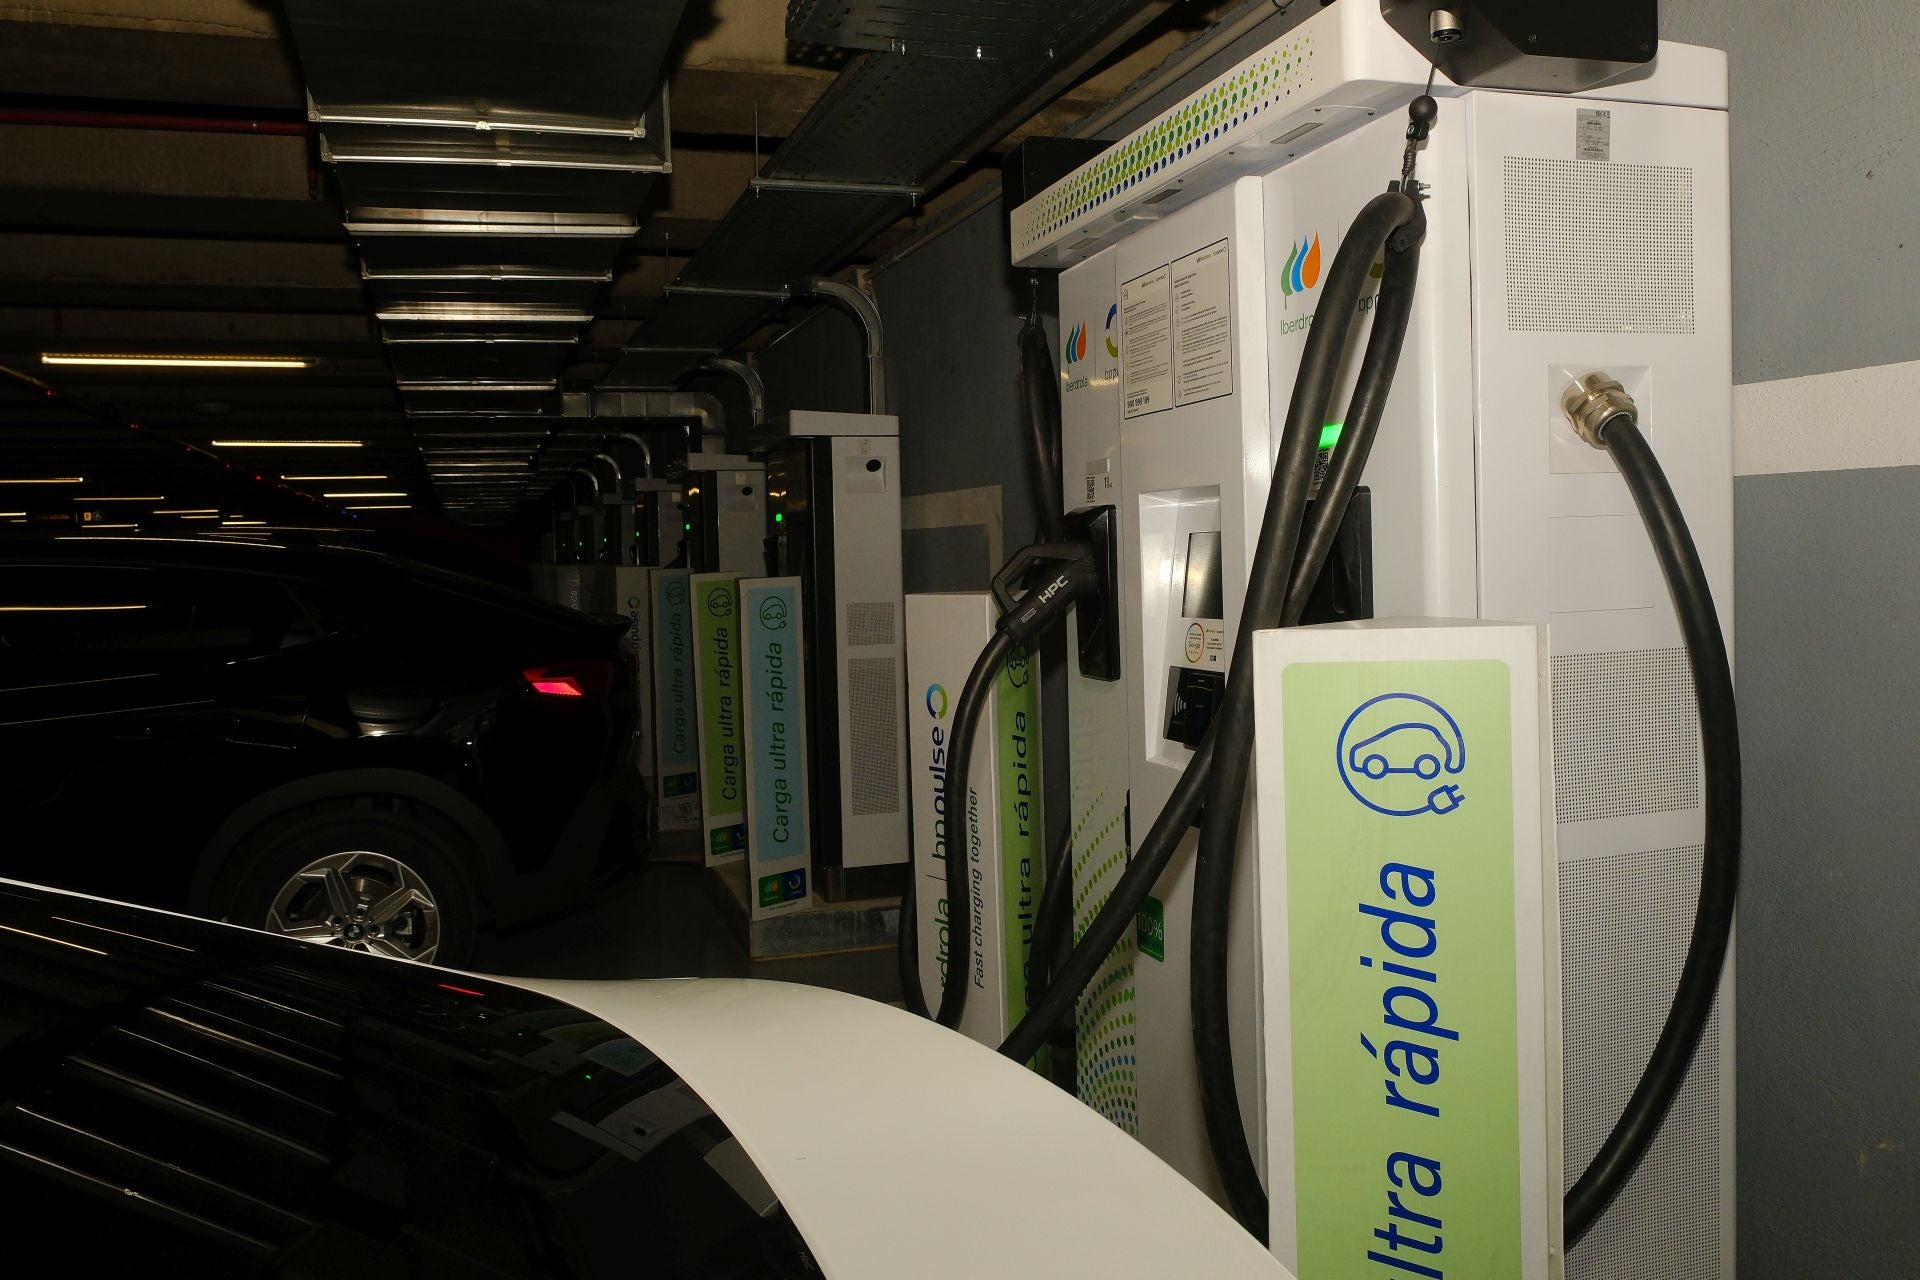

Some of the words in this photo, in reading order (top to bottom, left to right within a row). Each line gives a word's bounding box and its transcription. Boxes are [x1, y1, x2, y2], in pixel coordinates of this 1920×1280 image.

[1280, 313, 1315, 337] Iberdro
[1038, 574, 1069, 604] HPC
[671, 668, 684, 703] ultra
[712, 626, 734, 687] rápida
[765, 641, 788, 712] rápida
[673, 707, 688, 754] Carga
[717, 695, 734, 738] ultra
[768, 721, 787, 771] ultra
[722, 743, 739, 801] Carga
[1011, 710, 1033, 838] rápida
[772, 778, 792, 844] Carga
[968, 786, 982, 864] together
[970, 868, 984, 947] charging
[1018, 857, 1033, 945] ultra
[1137, 912, 1163, 941] 100%
[973, 950, 984, 989] Fast
[1358, 861, 1460, 1119] rápida
[1367, 1150, 1444, 1280] ltra
